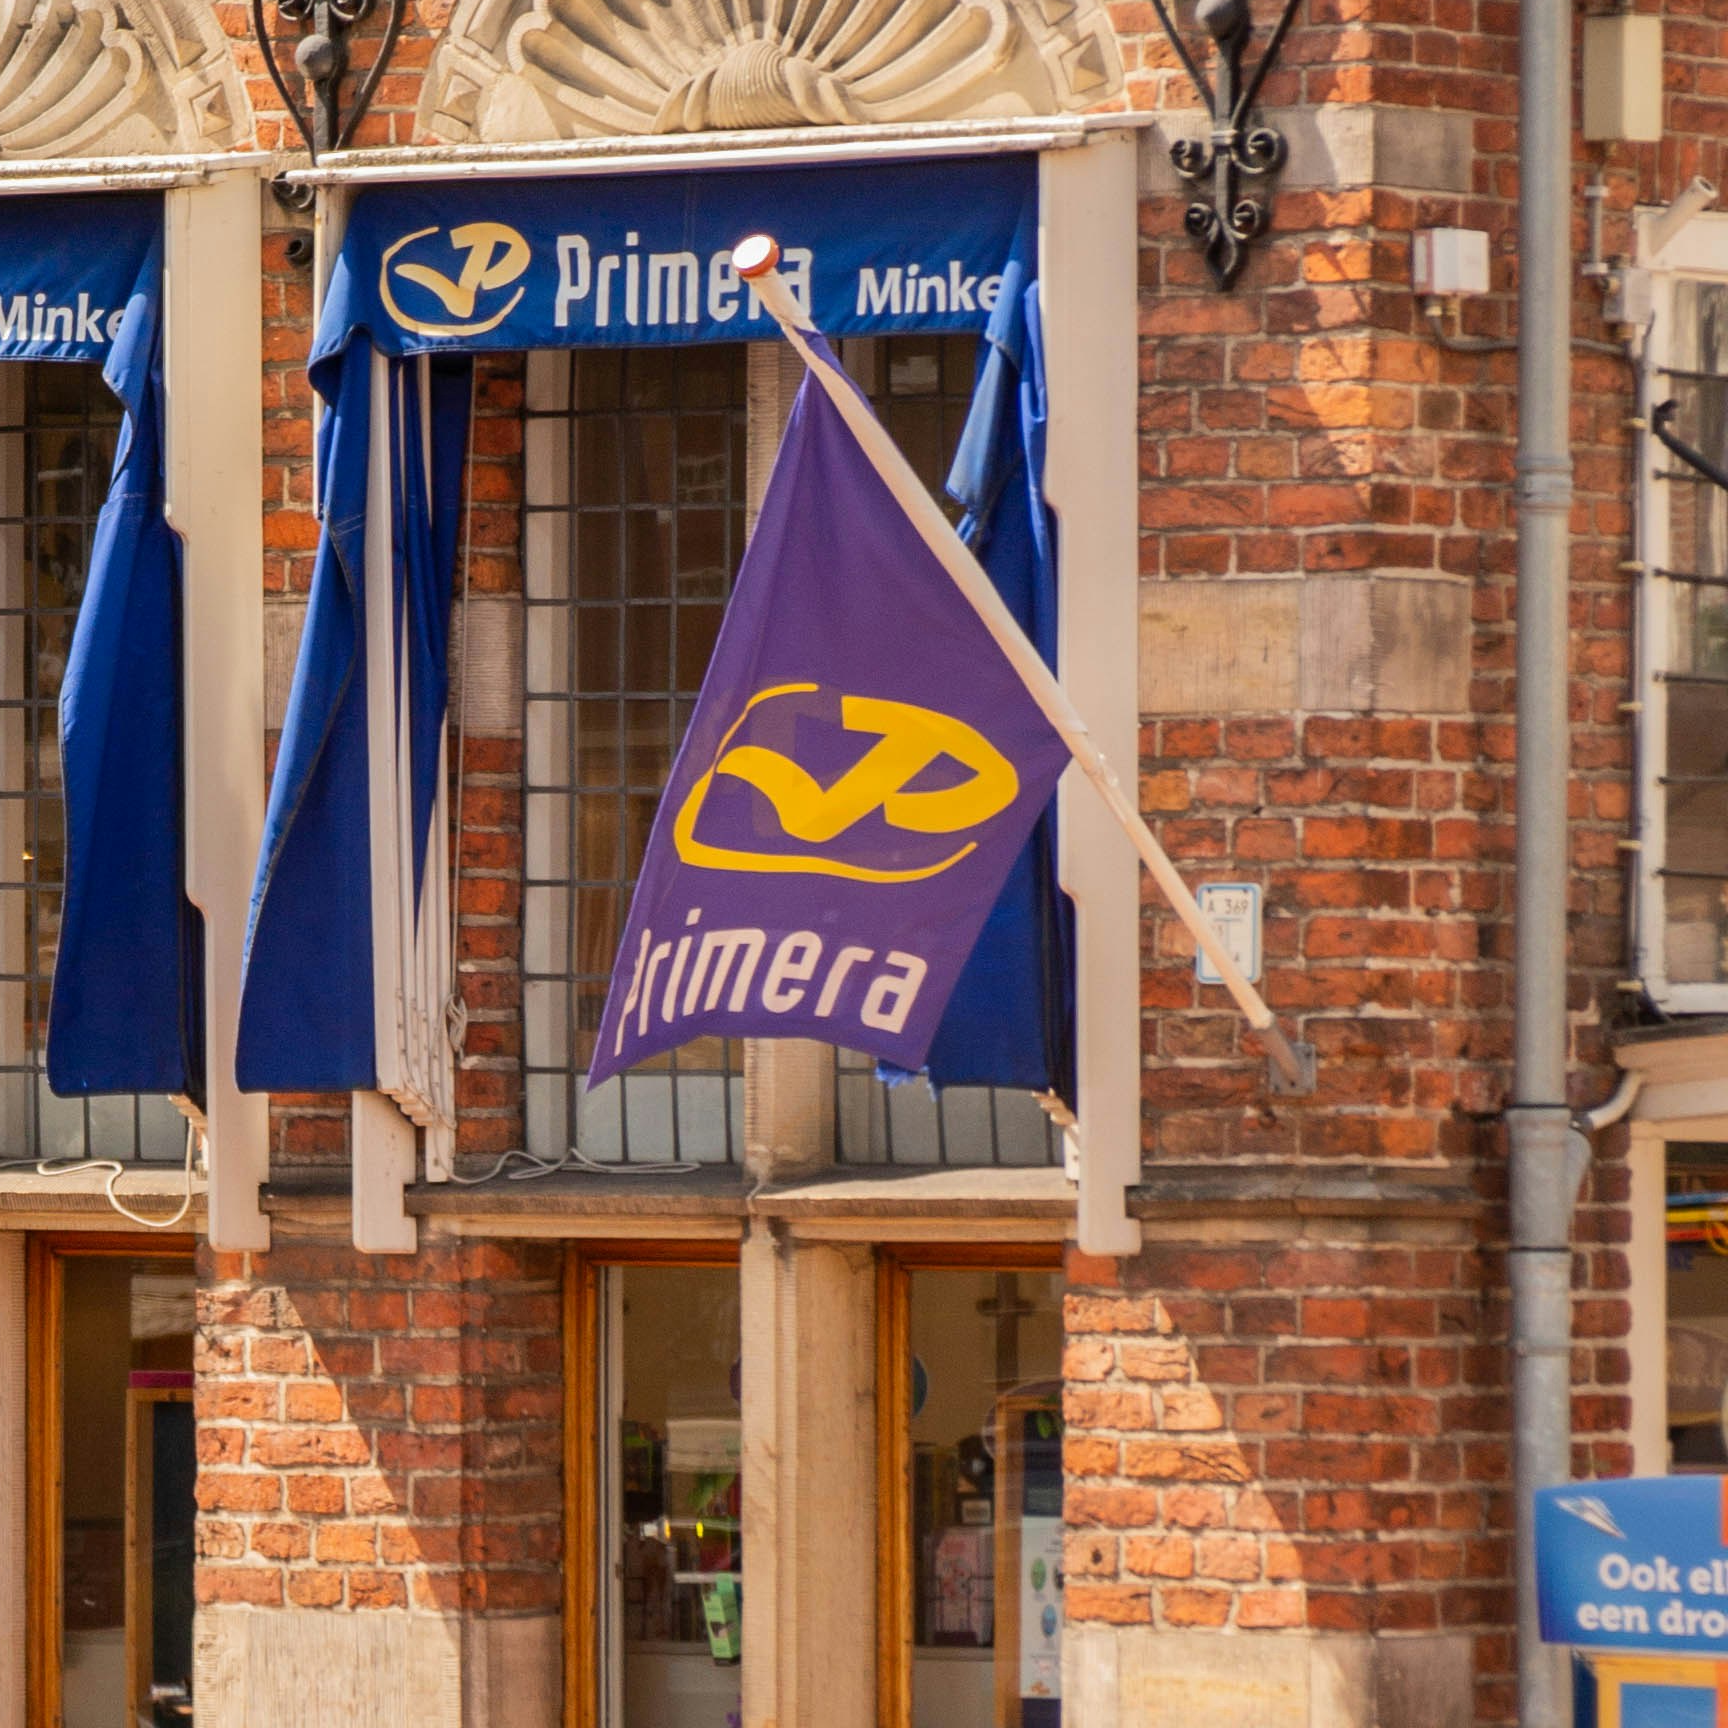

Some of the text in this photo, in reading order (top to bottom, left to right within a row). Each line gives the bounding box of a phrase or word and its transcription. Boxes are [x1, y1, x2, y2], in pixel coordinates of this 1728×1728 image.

[855, 259, 1003, 316] Minke
[1207, 898, 1216, 913] A
[1598, 1553, 1728, 1595] Ook el
[1577, 1599, 1728, 1638] een dro
